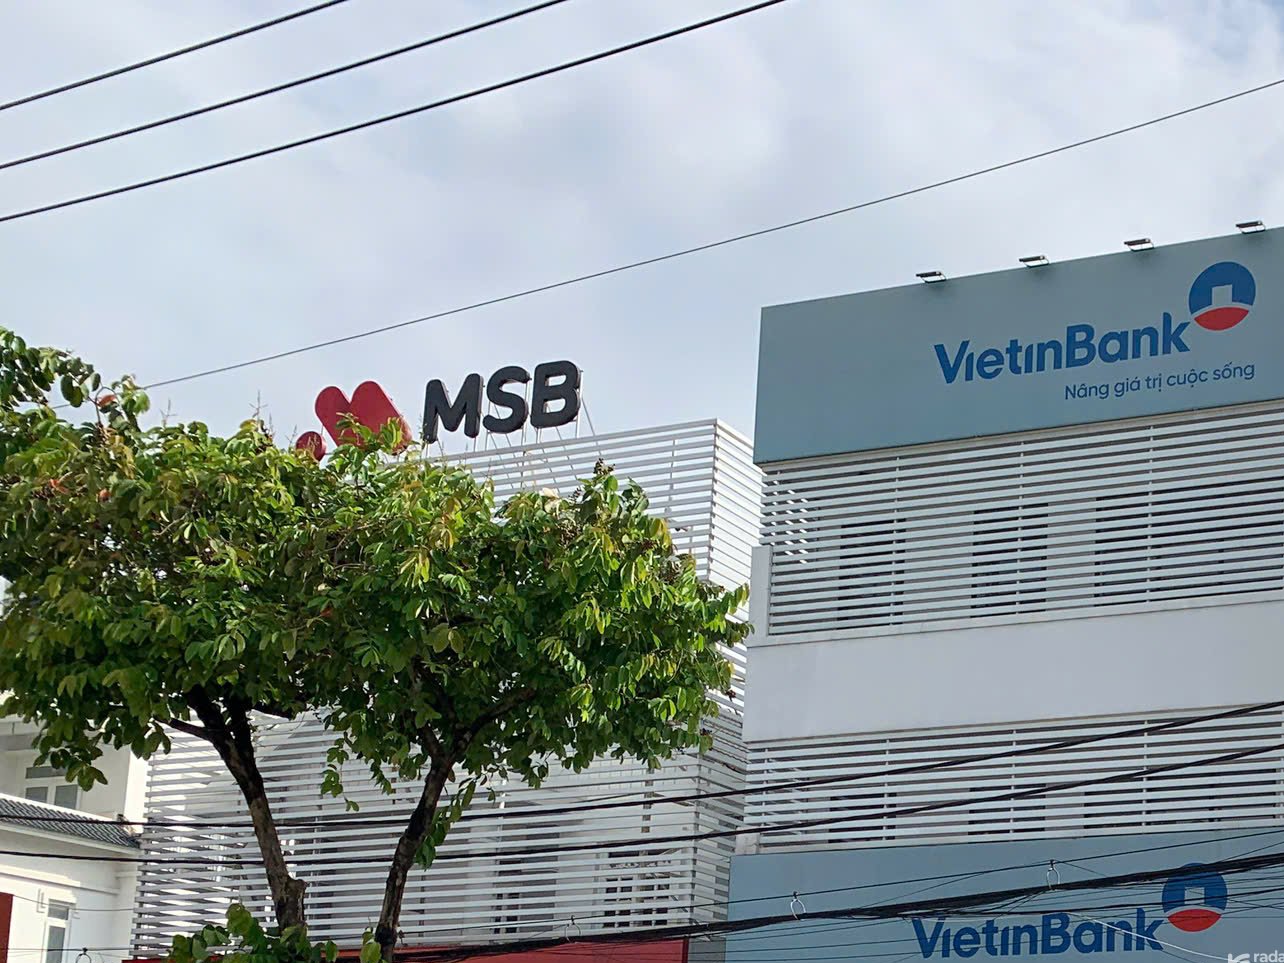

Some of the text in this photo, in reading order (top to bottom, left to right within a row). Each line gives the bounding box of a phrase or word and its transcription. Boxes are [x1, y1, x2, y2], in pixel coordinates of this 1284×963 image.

[934, 312, 1191, 384] VietinBank
[423, 360, 582, 444] MSB
[1065, 361, 1255, 400] Nâng giá trị cuộc sống
[911, 908, 1164, 959] VietinBank
